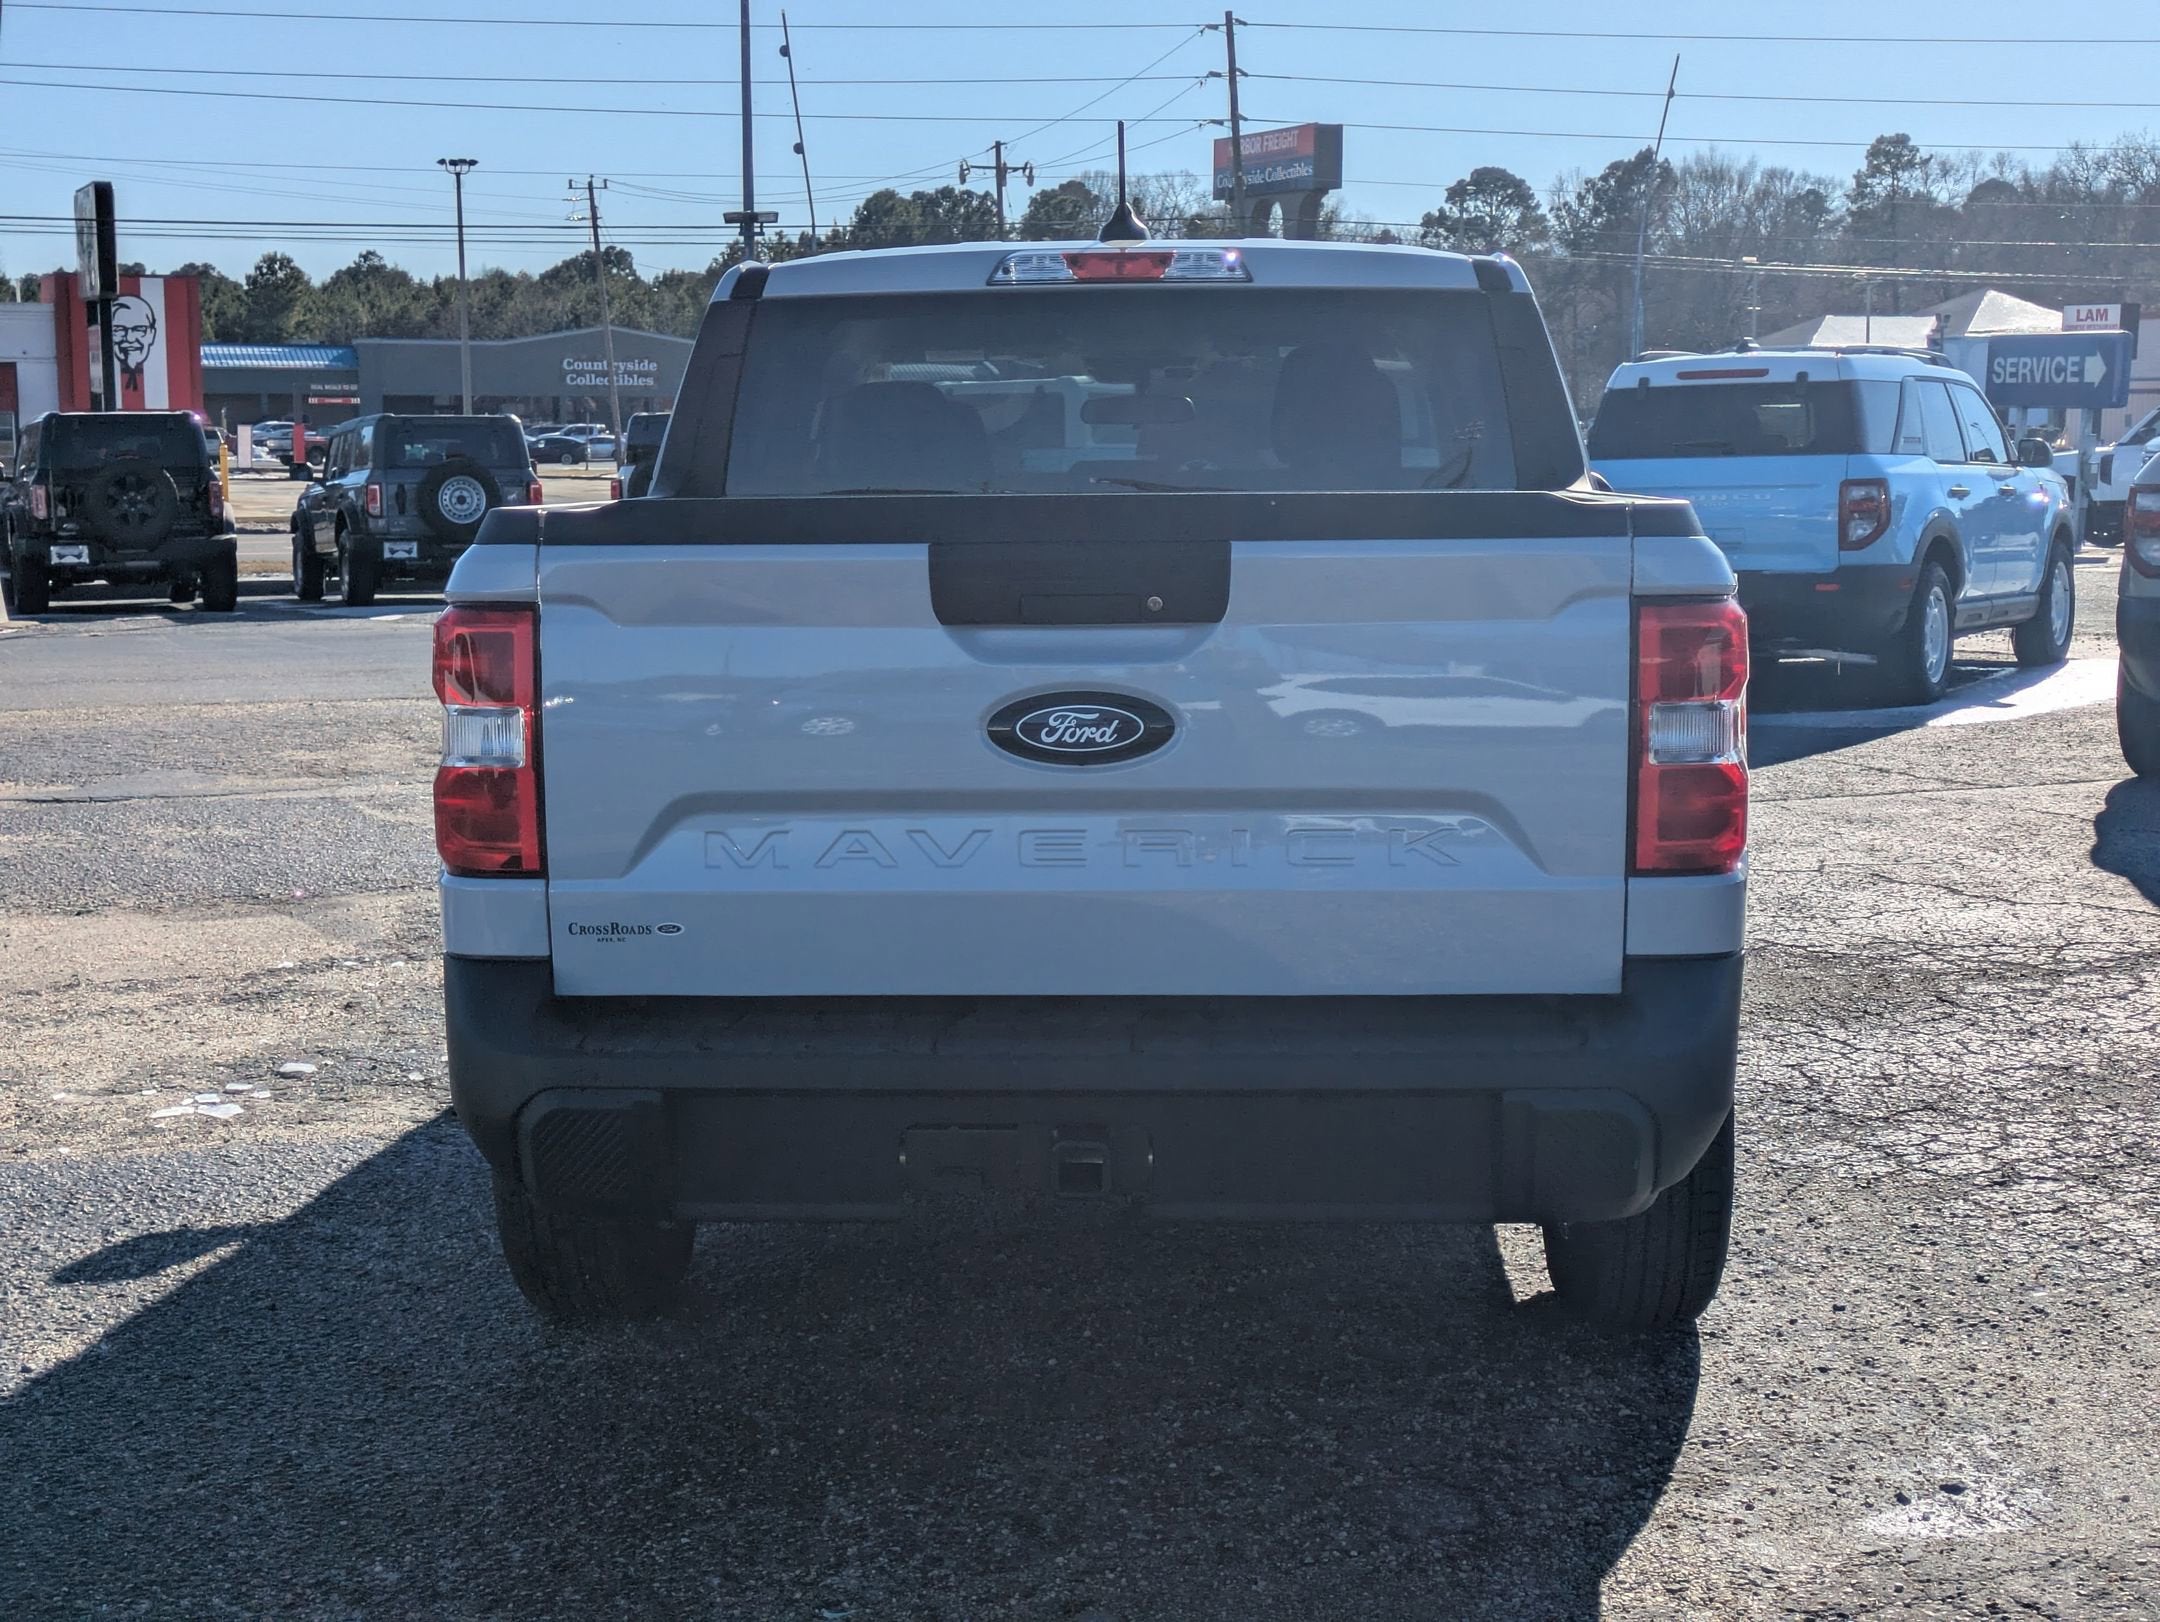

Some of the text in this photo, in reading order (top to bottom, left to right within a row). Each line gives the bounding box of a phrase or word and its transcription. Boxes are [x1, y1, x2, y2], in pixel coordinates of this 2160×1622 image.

[1263, 130, 1299, 152] FREIGHT
[2076, 308, 2108, 322] LAM
[1992, 356, 2080, 383] SERVICE
[1040, 711, 1120, 743] Ford
[703, 828, 1462, 869] MAVERICK
